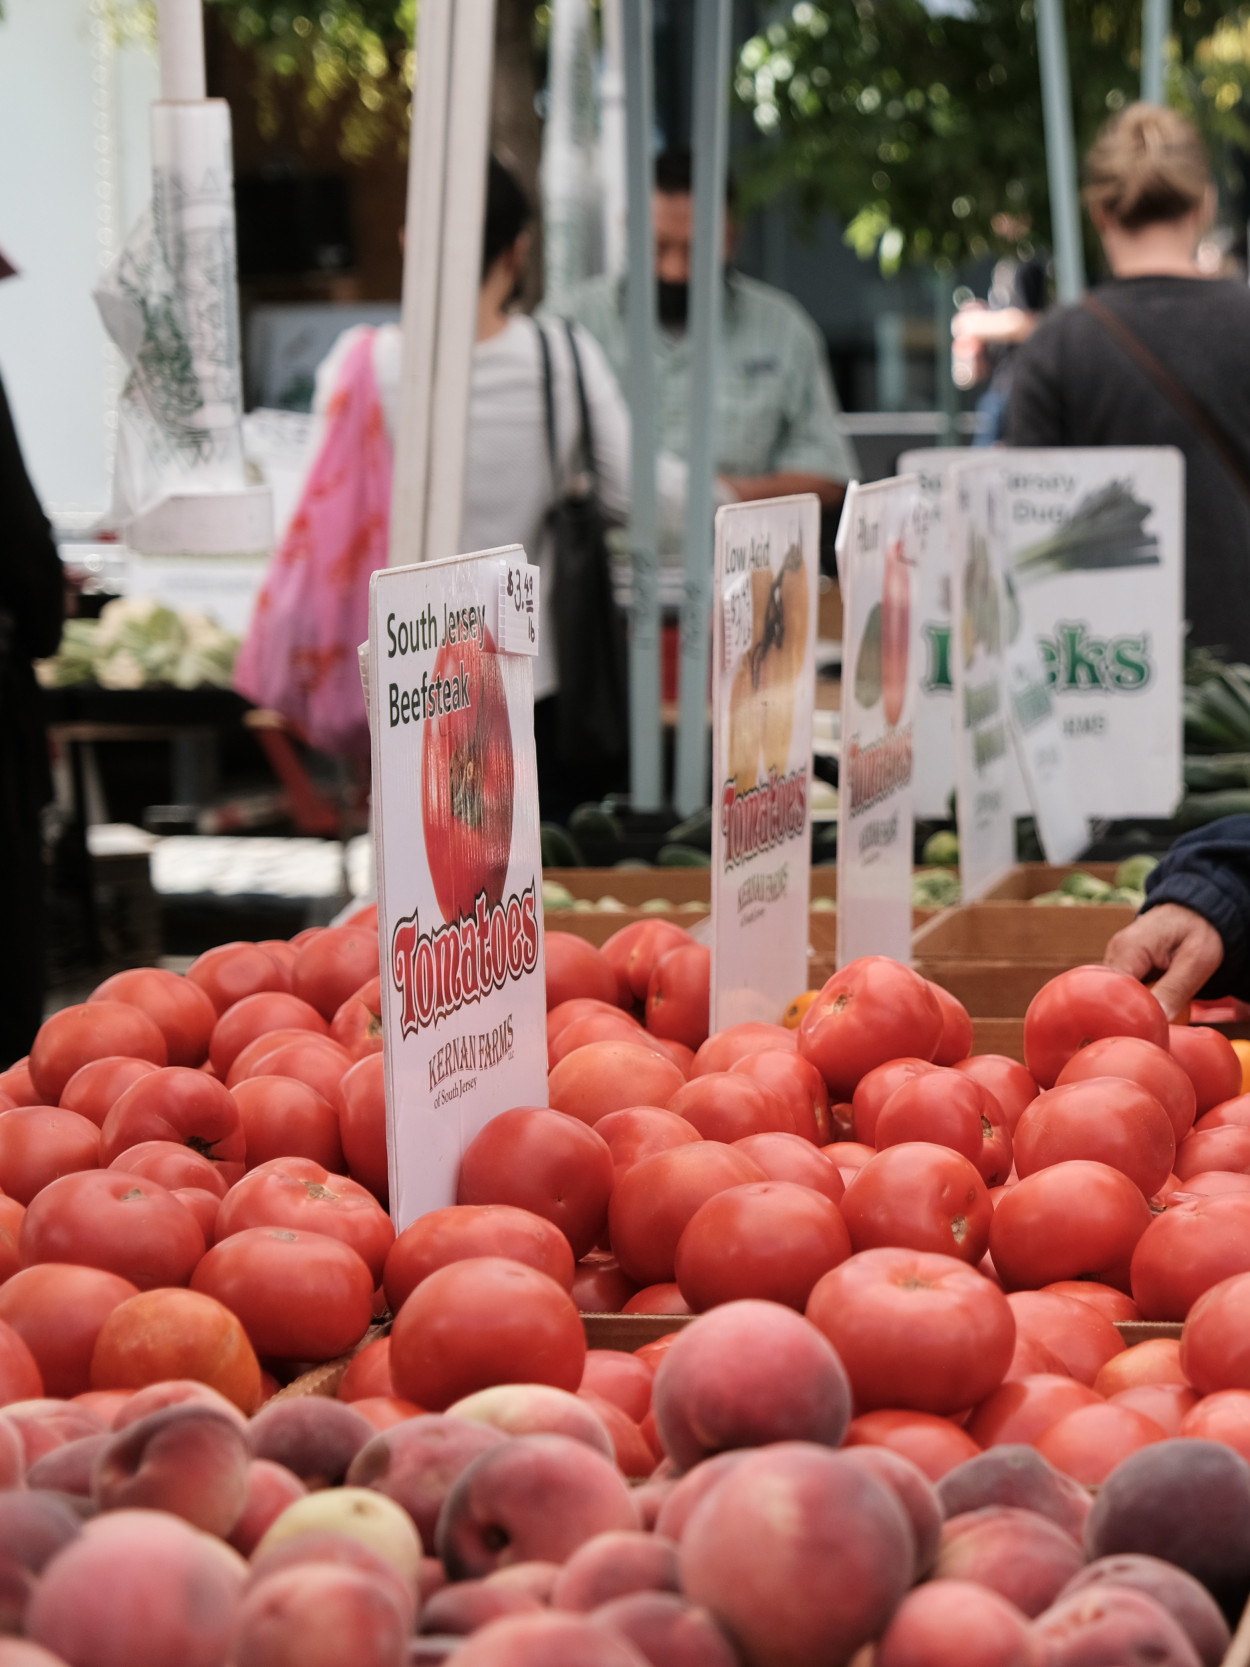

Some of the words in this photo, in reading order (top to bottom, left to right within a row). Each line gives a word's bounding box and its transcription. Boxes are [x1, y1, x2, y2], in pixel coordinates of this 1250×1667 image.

[725, 541, 747, 575] Low
[507, 567, 534, 613] $3.49
[386, 602, 438, 659] South
[441, 603, 486, 650] Jersey
[388, 660, 472, 729] Beefsteak
[721, 763, 807, 876] Tomatoes
[391, 873, 538, 1043] Tomatoes
[428, 1034, 477, 1093] KERNAN
[478, 1013, 514, 1072] FARMS
[441, 1081, 460, 1106] South
[458, 1076, 478, 1098] Jersey
